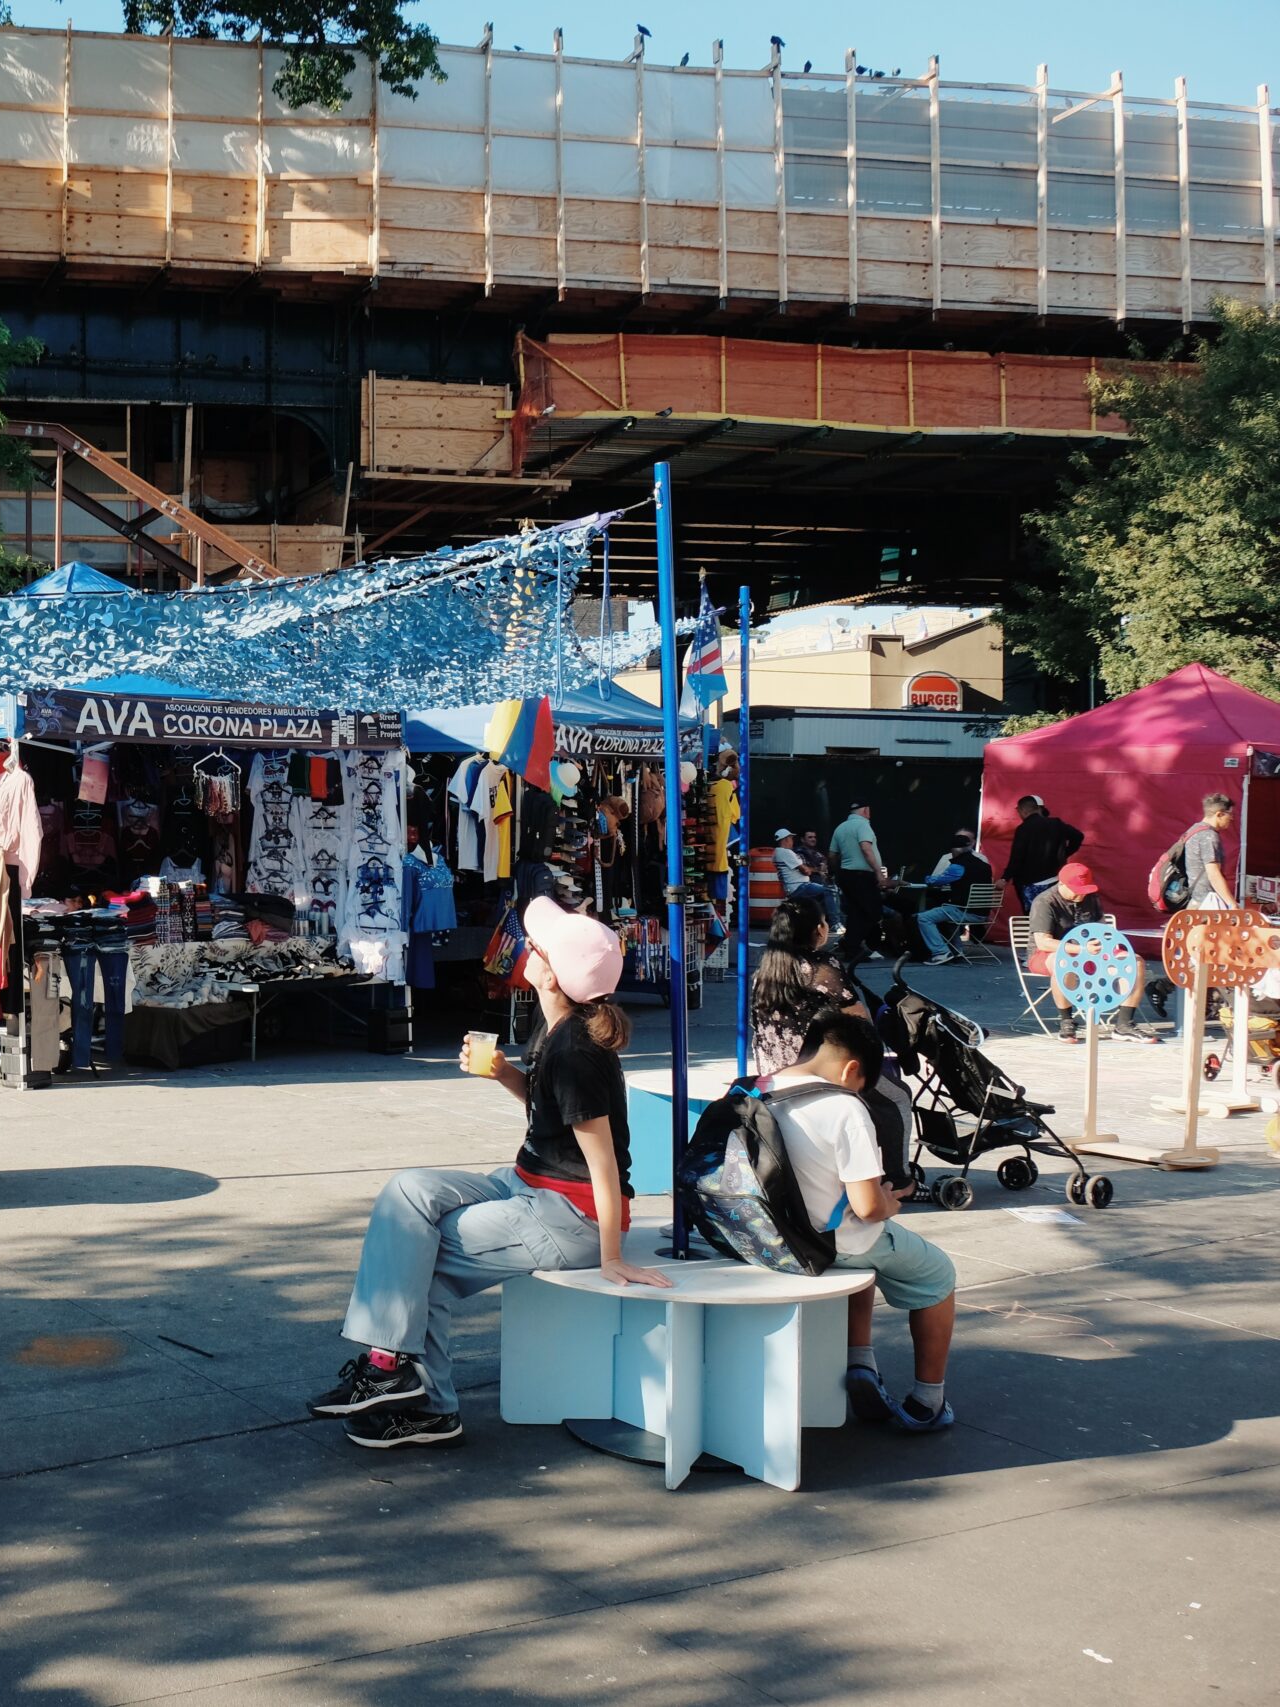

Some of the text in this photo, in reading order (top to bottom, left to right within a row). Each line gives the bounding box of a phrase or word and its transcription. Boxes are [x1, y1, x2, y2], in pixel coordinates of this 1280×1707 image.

[165, 703, 320, 717] ASOCIACIÓN DE VENDEDORES AMBULANTES
[911, 693, 958, 706] BURGER
[75, 697, 157, 737] AVA
[163, 713, 323, 738] CORONA PLAZA
[347, 715, 355, 744] CENTER
[331, 720, 339, 747] URBAN
[380, 731, 402, 739] Project
[555, 723, 592, 753] AVA
[595, 735, 640, 752] CORONA
